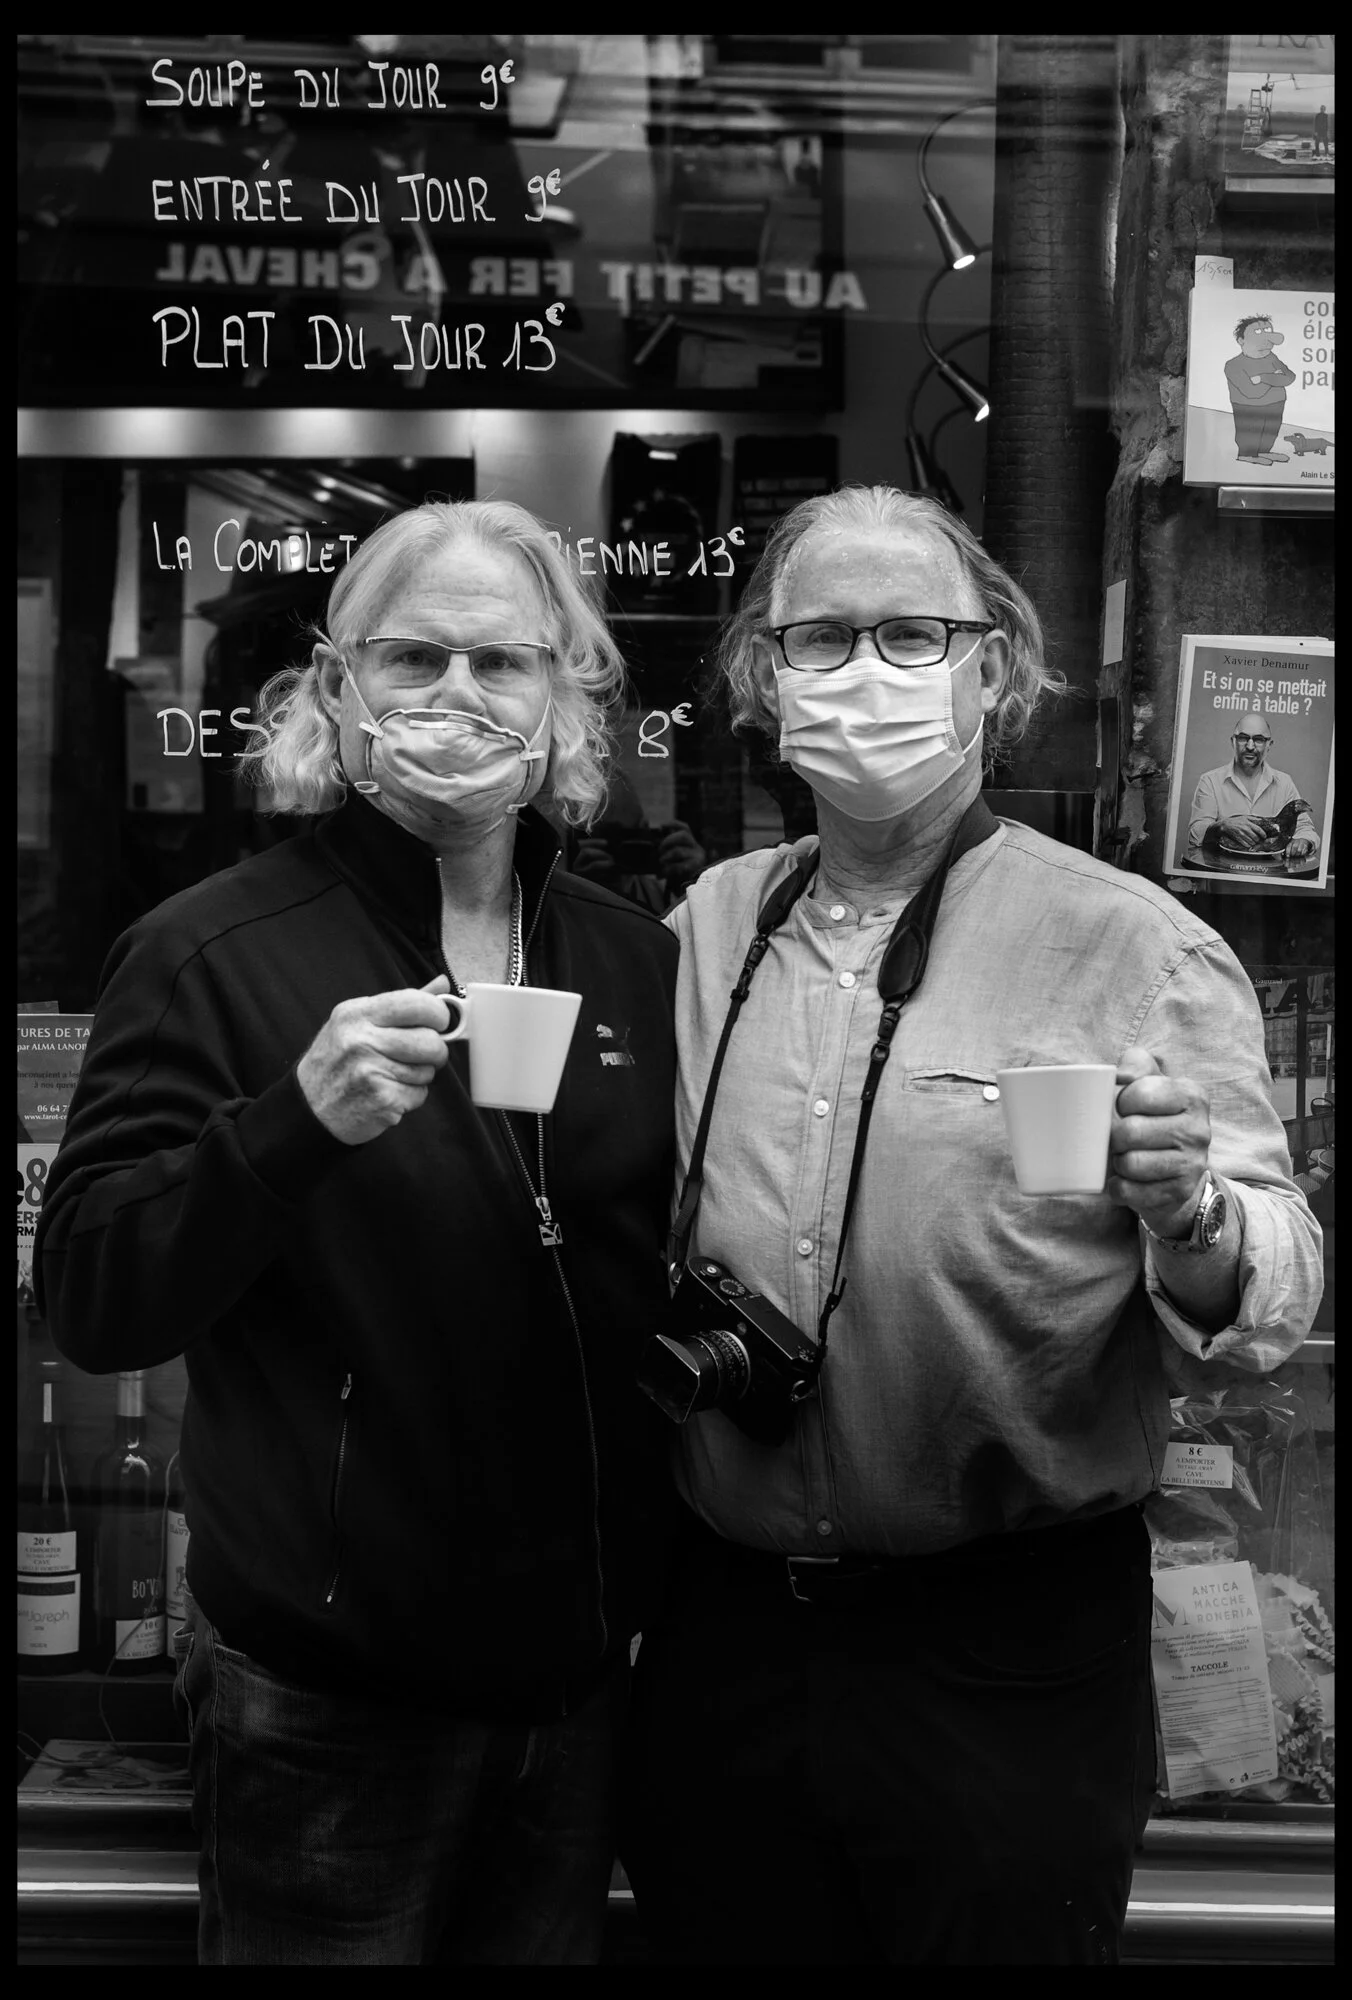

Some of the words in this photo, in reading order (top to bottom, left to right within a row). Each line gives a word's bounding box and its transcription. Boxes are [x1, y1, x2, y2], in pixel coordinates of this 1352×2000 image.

[146, 59, 265, 107] SOUPE
[294, 68, 340, 108] DU
[368, 61, 446, 109] JOUR
[480, 59, 516, 110] 9€
[152, 159, 302, 221] ENTRÉE
[326, 181, 380, 222] DU
[397, 173, 496, 222] JOUR
[525, 168, 561, 221] 9€
[153, 306, 276, 369] PLAT
[305, 315, 366, 370] DU
[392, 316, 486, 371] JOUR
[502, 302, 566, 371] 13€
[1301, 471, 1318, 479] Alain
[1319, 472, 1328, 480] Le
[153, 521, 193, 572] LA
[688, 527, 745, 577] 13€
[1223, 655, 1257, 667] Xavier
[1261, 658, 1310, 671] Denamur
[1202, 670, 1217, 689] Et
[1220, 672, 1232, 690] si
[1236, 677, 1253, 691] on
[1257, 679, 1274, 694] se
[1278, 679, 1327, 698] mettait
[1213, 692, 1249, 711] enfin
[1252, 694, 1261, 712] à
[1265, 696, 1299, 715] table
[1303, 698, 1313, 716] ?
[638, 703, 694, 758] 8€
[17, 1028, 51, 1038] URES
[55, 1028, 71, 1038] DE
[17, 1044, 30, 1053] par
[31, 1043, 55, 1051] ALMA
[37, 1105, 48, 1113] 06
[50, 1105, 60, 1113] 64
[62, 1105, 69, 1113] 7
[1189, 1447, 1194, 1456] 8
[1197, 1447, 1203, 1456] €
[33, 1537, 44, 1546] 20
[46, 1537, 52, 1546] €
[1192, 1582, 1239, 1596] ANTICA
[1194, 1594, 1246, 1610] MACCHE
[1197, 1608, 1254, 1624] RONERIA
[1191, 1661, 1229, 1672] TACCOLE
